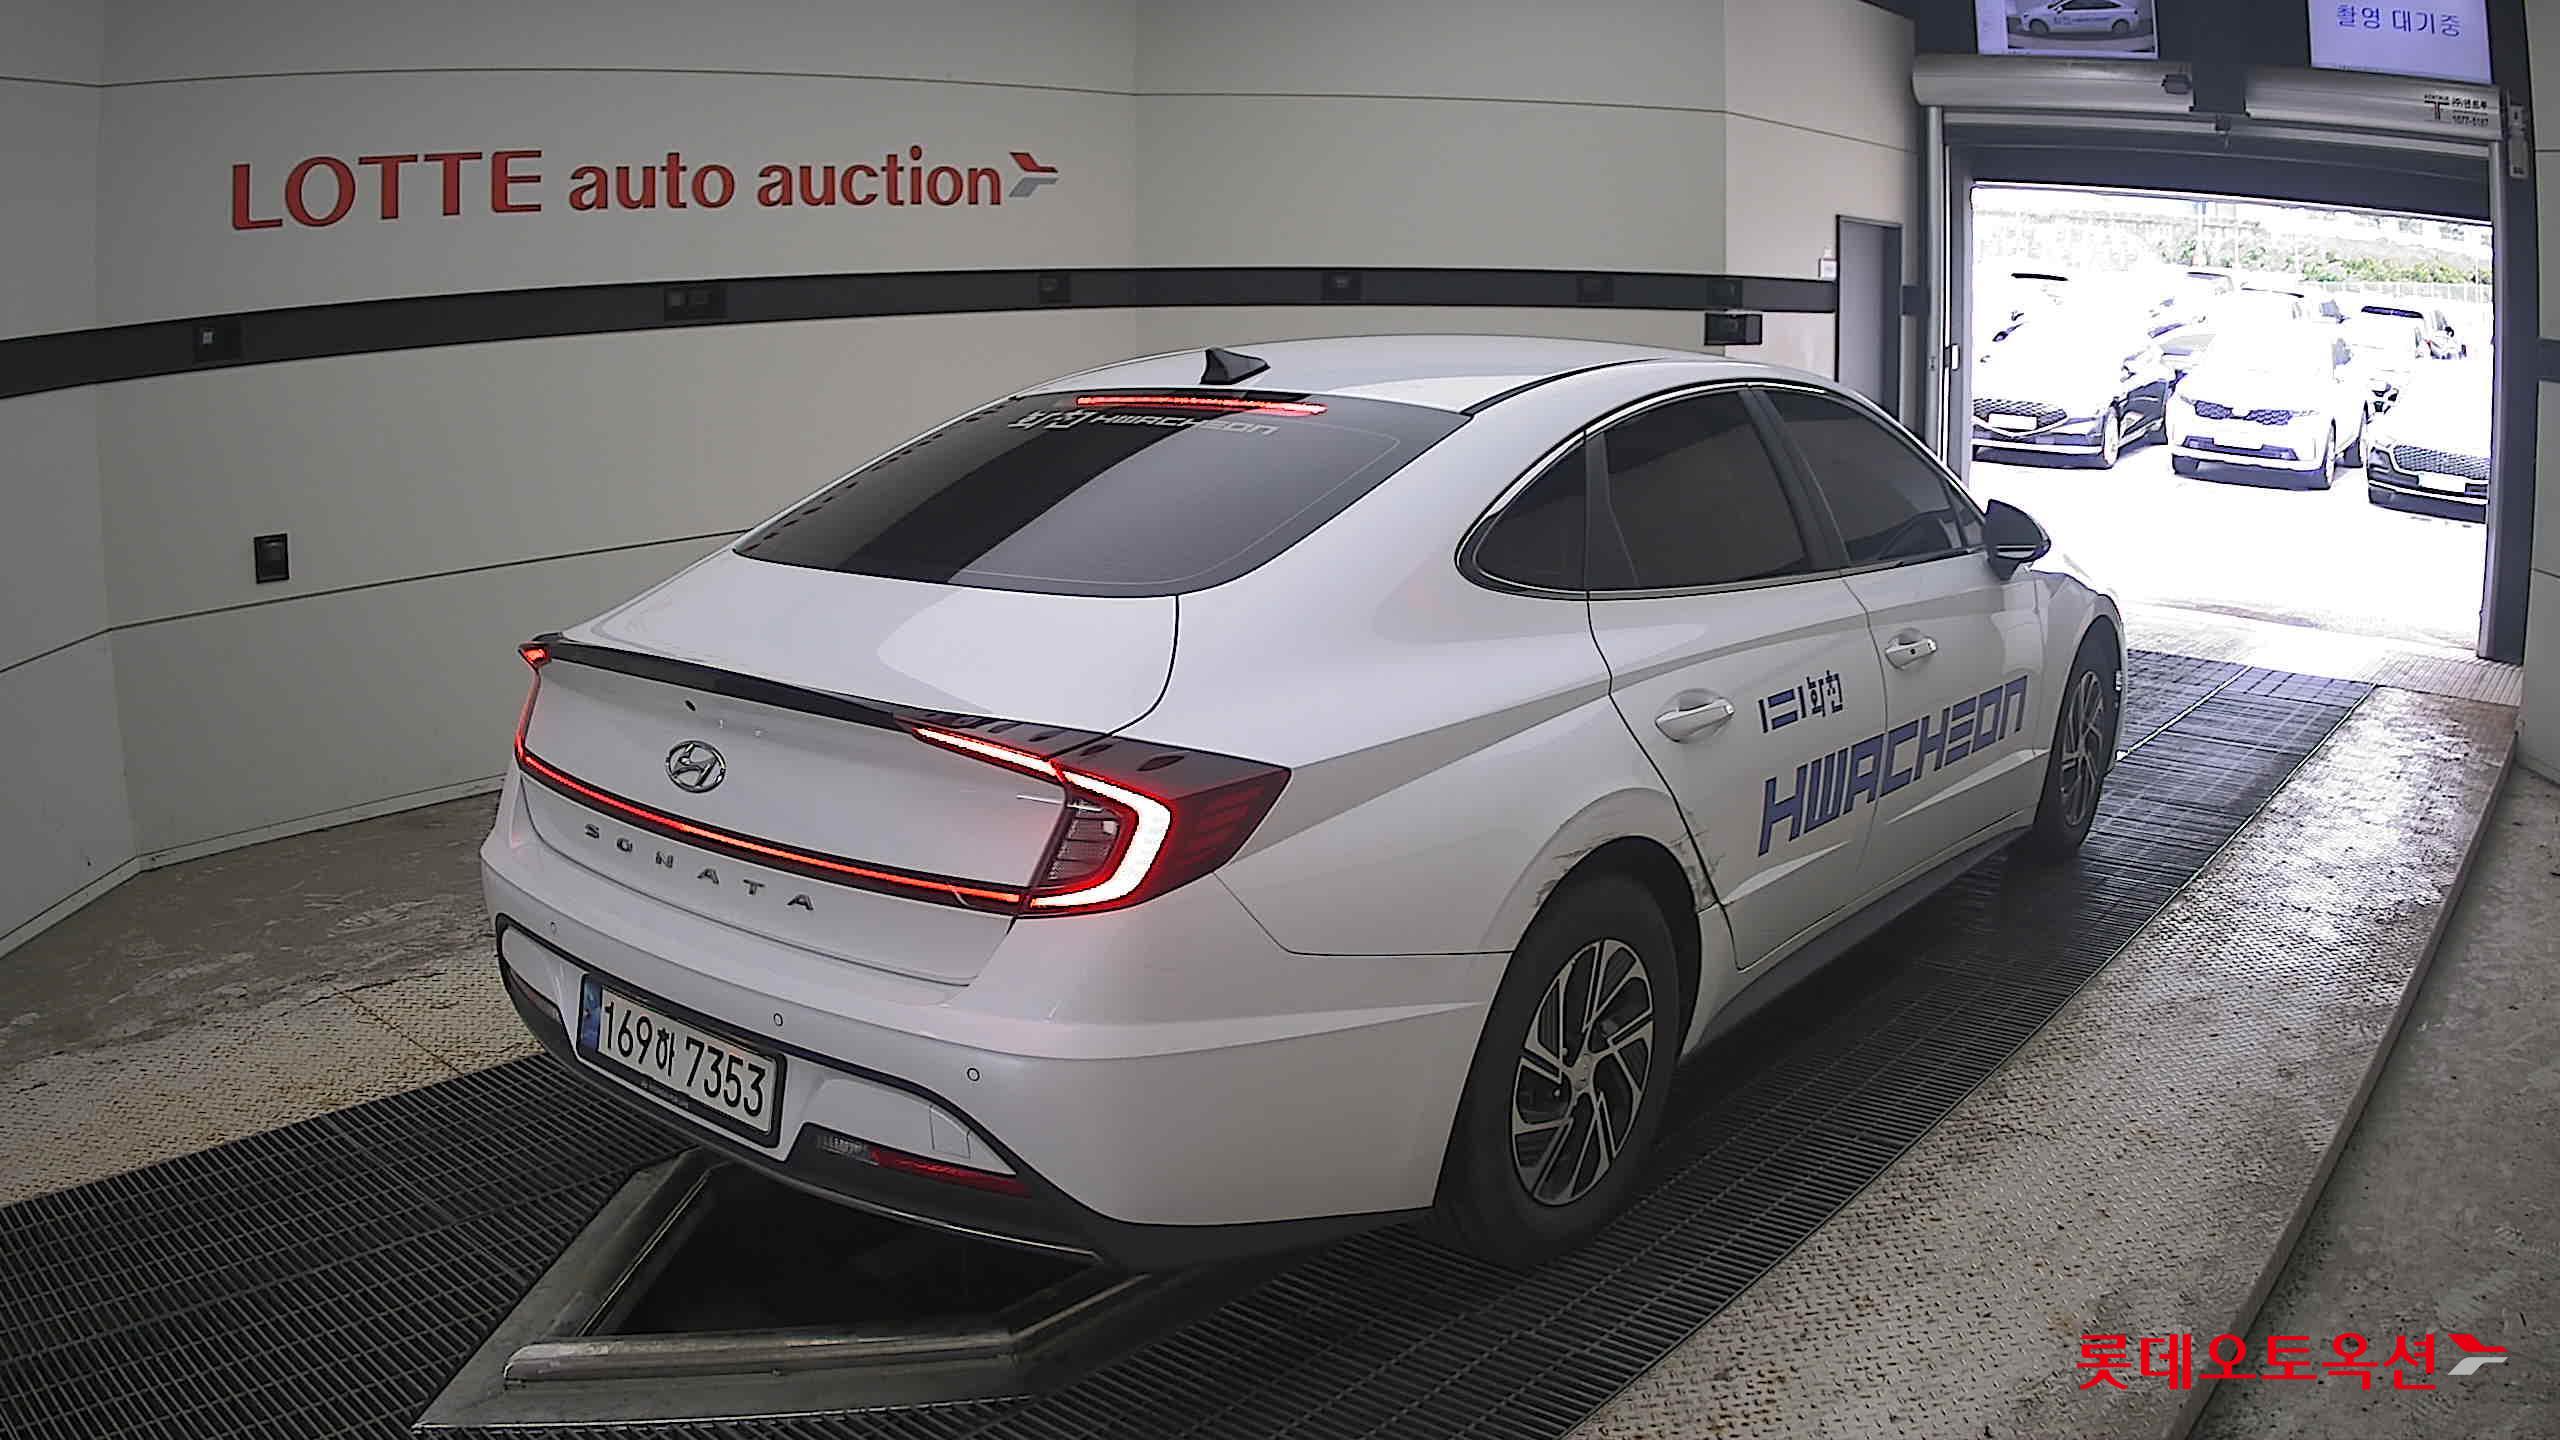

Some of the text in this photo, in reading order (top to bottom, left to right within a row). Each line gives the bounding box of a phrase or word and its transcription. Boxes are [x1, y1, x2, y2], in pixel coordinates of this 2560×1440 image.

[2337, 4, 2461, 37] 촬영 대기중
[232, 145, 1002, 230] LOTTE auto auction
[1087, 414, 1281, 436] HWACHEON
[1758, 675, 2028, 857] HWACHEON
[584, 823, 814, 911] SONATA
[604, 1001, 676, 1077] 169하
[685, 1037, 767, 1117] 7353
